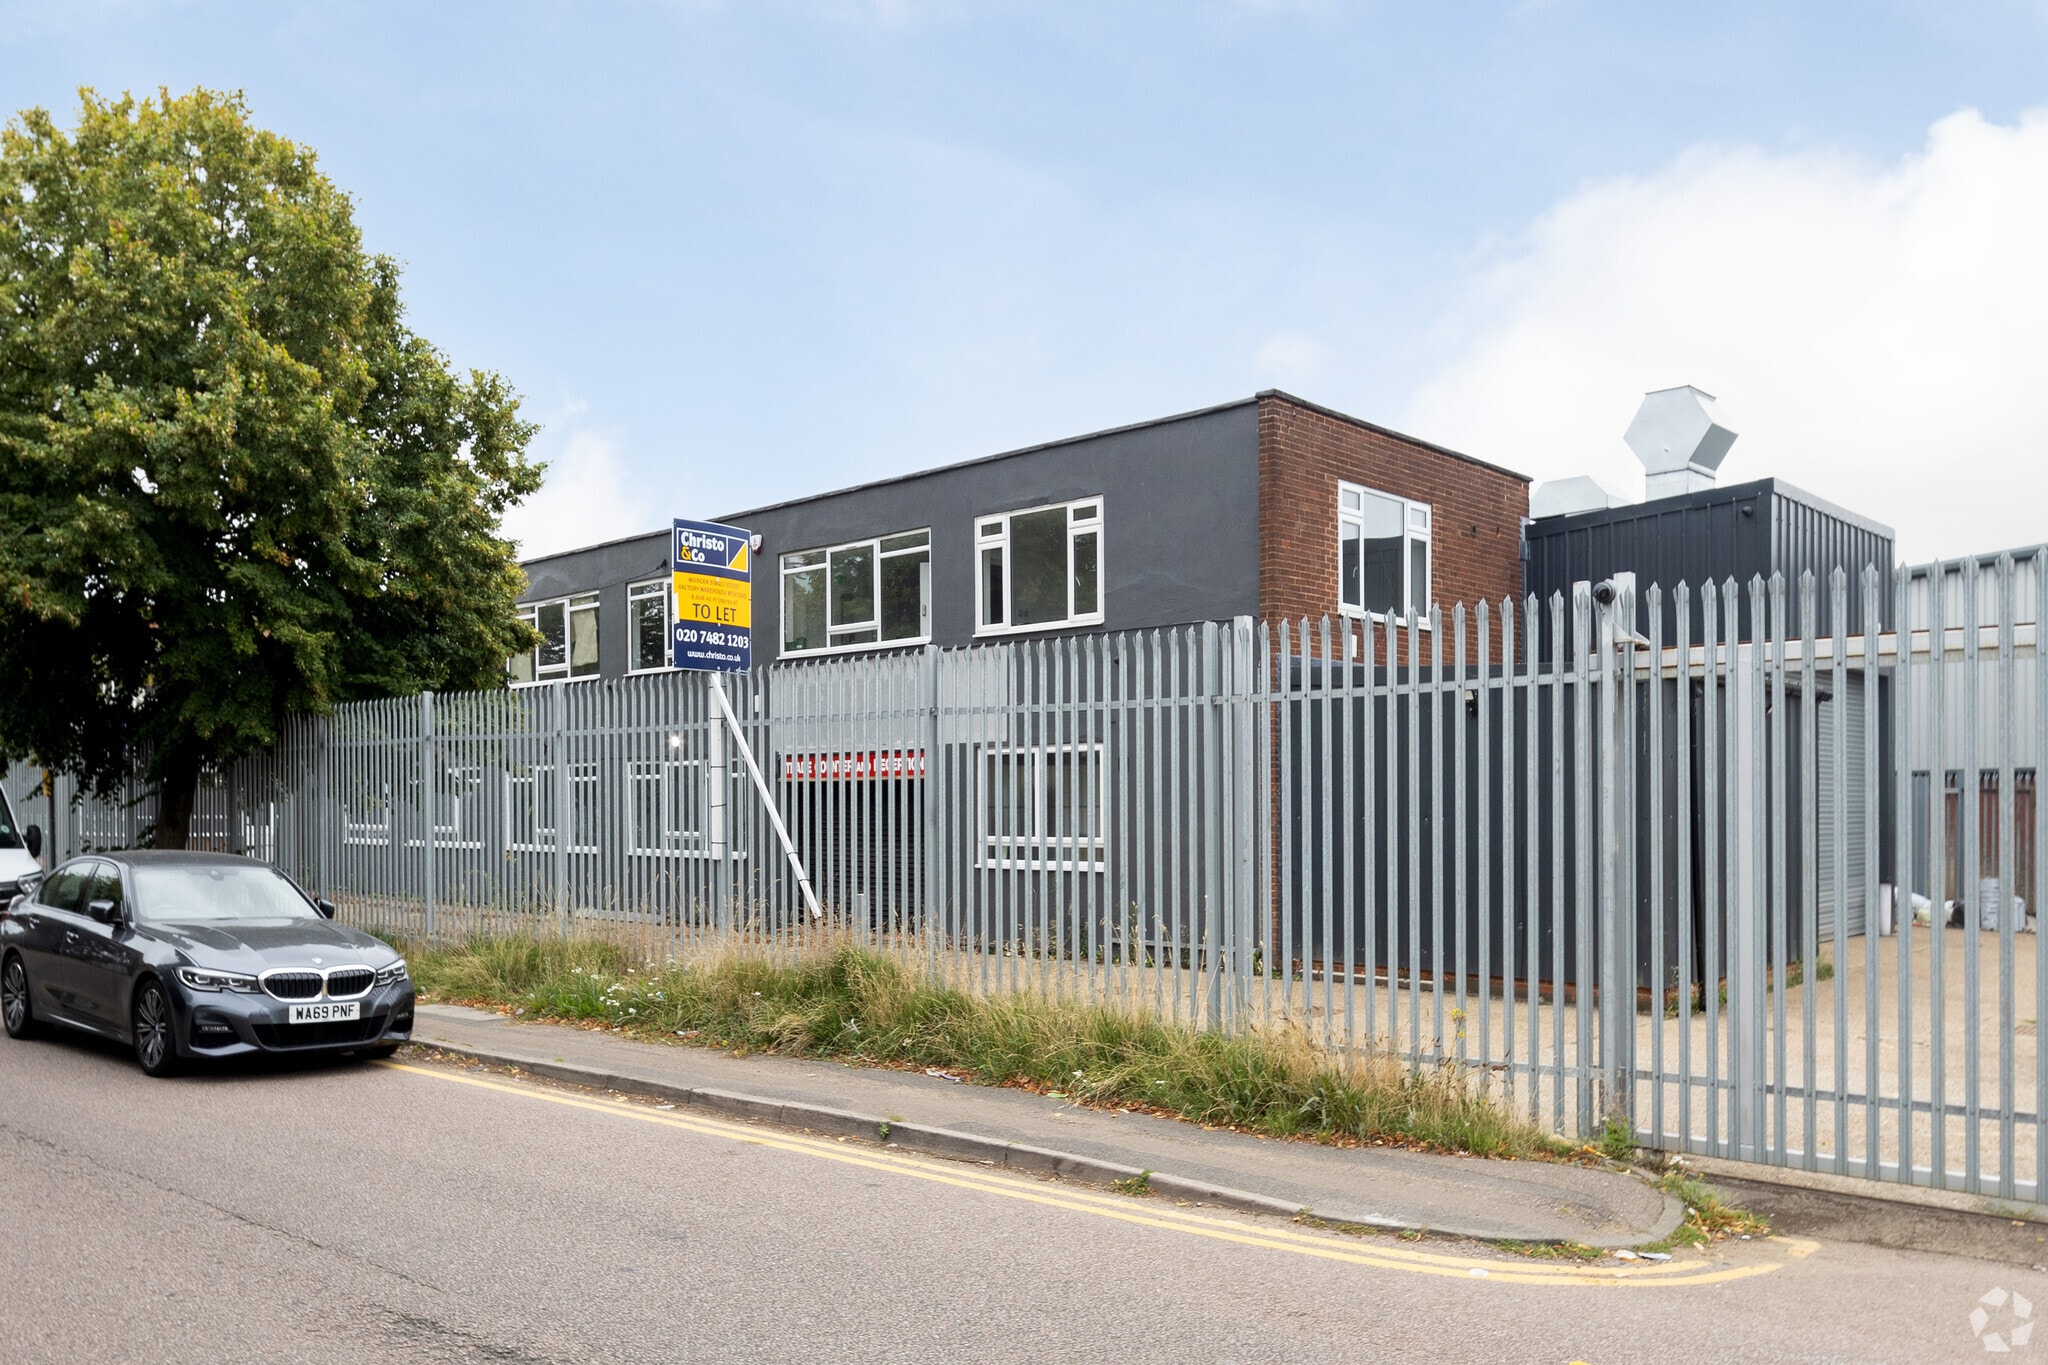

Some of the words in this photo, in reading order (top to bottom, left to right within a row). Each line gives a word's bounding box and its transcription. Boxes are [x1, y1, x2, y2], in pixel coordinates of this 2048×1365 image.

[681, 532, 724, 552] Christo
[681, 546, 705, 563] &Co
[689, 577, 709, 585] MODERN
[700, 587, 726, 595] WAREHOUSE
[692, 603, 711, 619] TO
[716, 606, 737, 622] LET
[676, 628, 698, 643] 020
[700, 630, 726, 646] 7482
[727, 633, 749, 649] 1203
[687, 650, 741, 662] www.christo.co.uk
[296, 1006, 329, 1020] WA69
[332, 1004, 355, 1018] PNF
